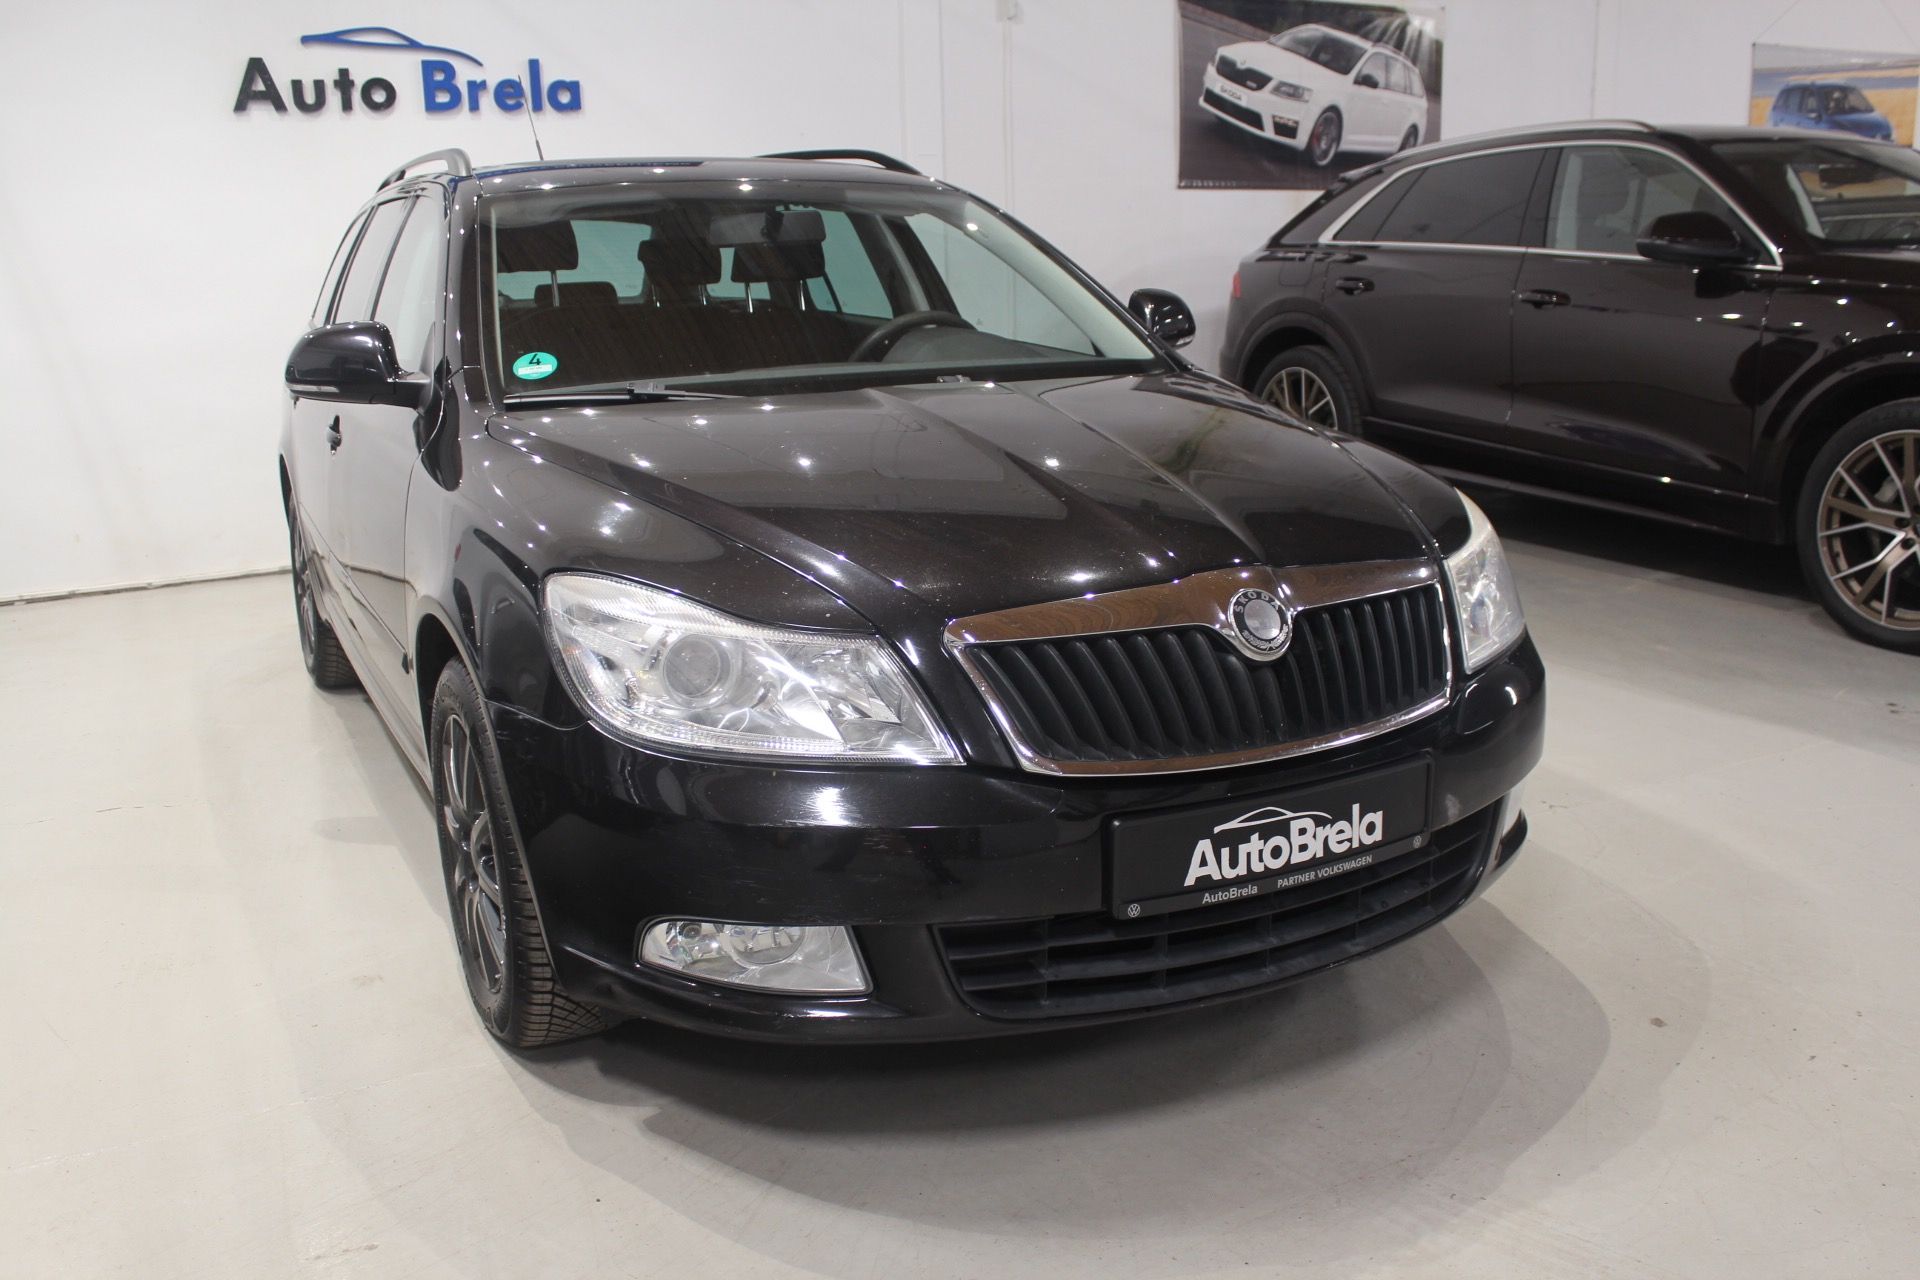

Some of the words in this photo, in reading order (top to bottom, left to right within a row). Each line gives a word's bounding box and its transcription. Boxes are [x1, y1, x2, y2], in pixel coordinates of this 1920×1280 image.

[233, 57, 397, 114] Auto
[420, 58, 582, 114] Brela
[529, 353, 542, 365] 4
[1184, 803, 1384, 887] AutoBrela
[1277, 871, 1316, 888] PARTNER
[1317, 855, 1373, 877] VOLKSWAGEN
[1202, 885, 1258, 904] AutoBrela
